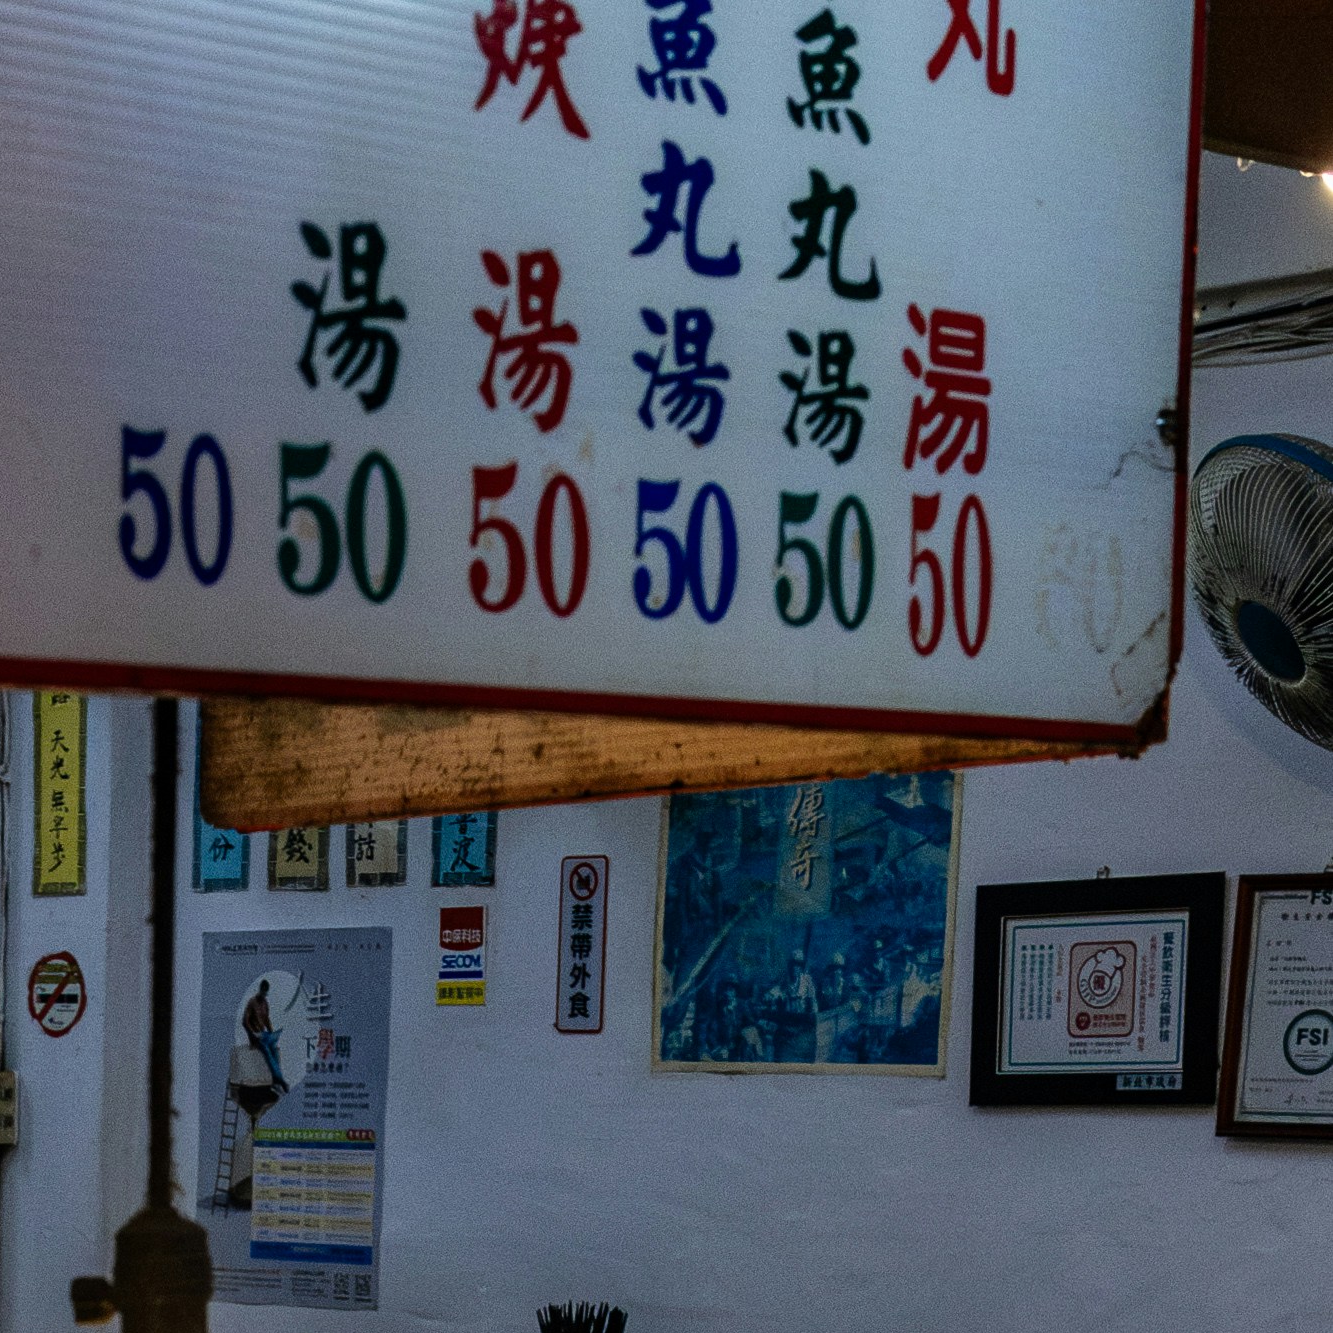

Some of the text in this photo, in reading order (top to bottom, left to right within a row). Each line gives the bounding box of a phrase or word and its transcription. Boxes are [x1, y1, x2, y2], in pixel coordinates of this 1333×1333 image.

[631, 0, 742, 624] 魚丸湯 50
[774, 9, 882, 631] 魚丸湯 50
[277, 222, 407, 604] 湯 50
[118, 425, 233, 586] 50
[469, 463, 590, 618] 50
[909, 494, 992, 657] 50
[442, 929, 482, 943] 中保科技
[442, 955, 481, 968] SECOM
[569, 904, 593, 1018] 禁帶外食
[1295, 1027, 1330, 1046] FSI
